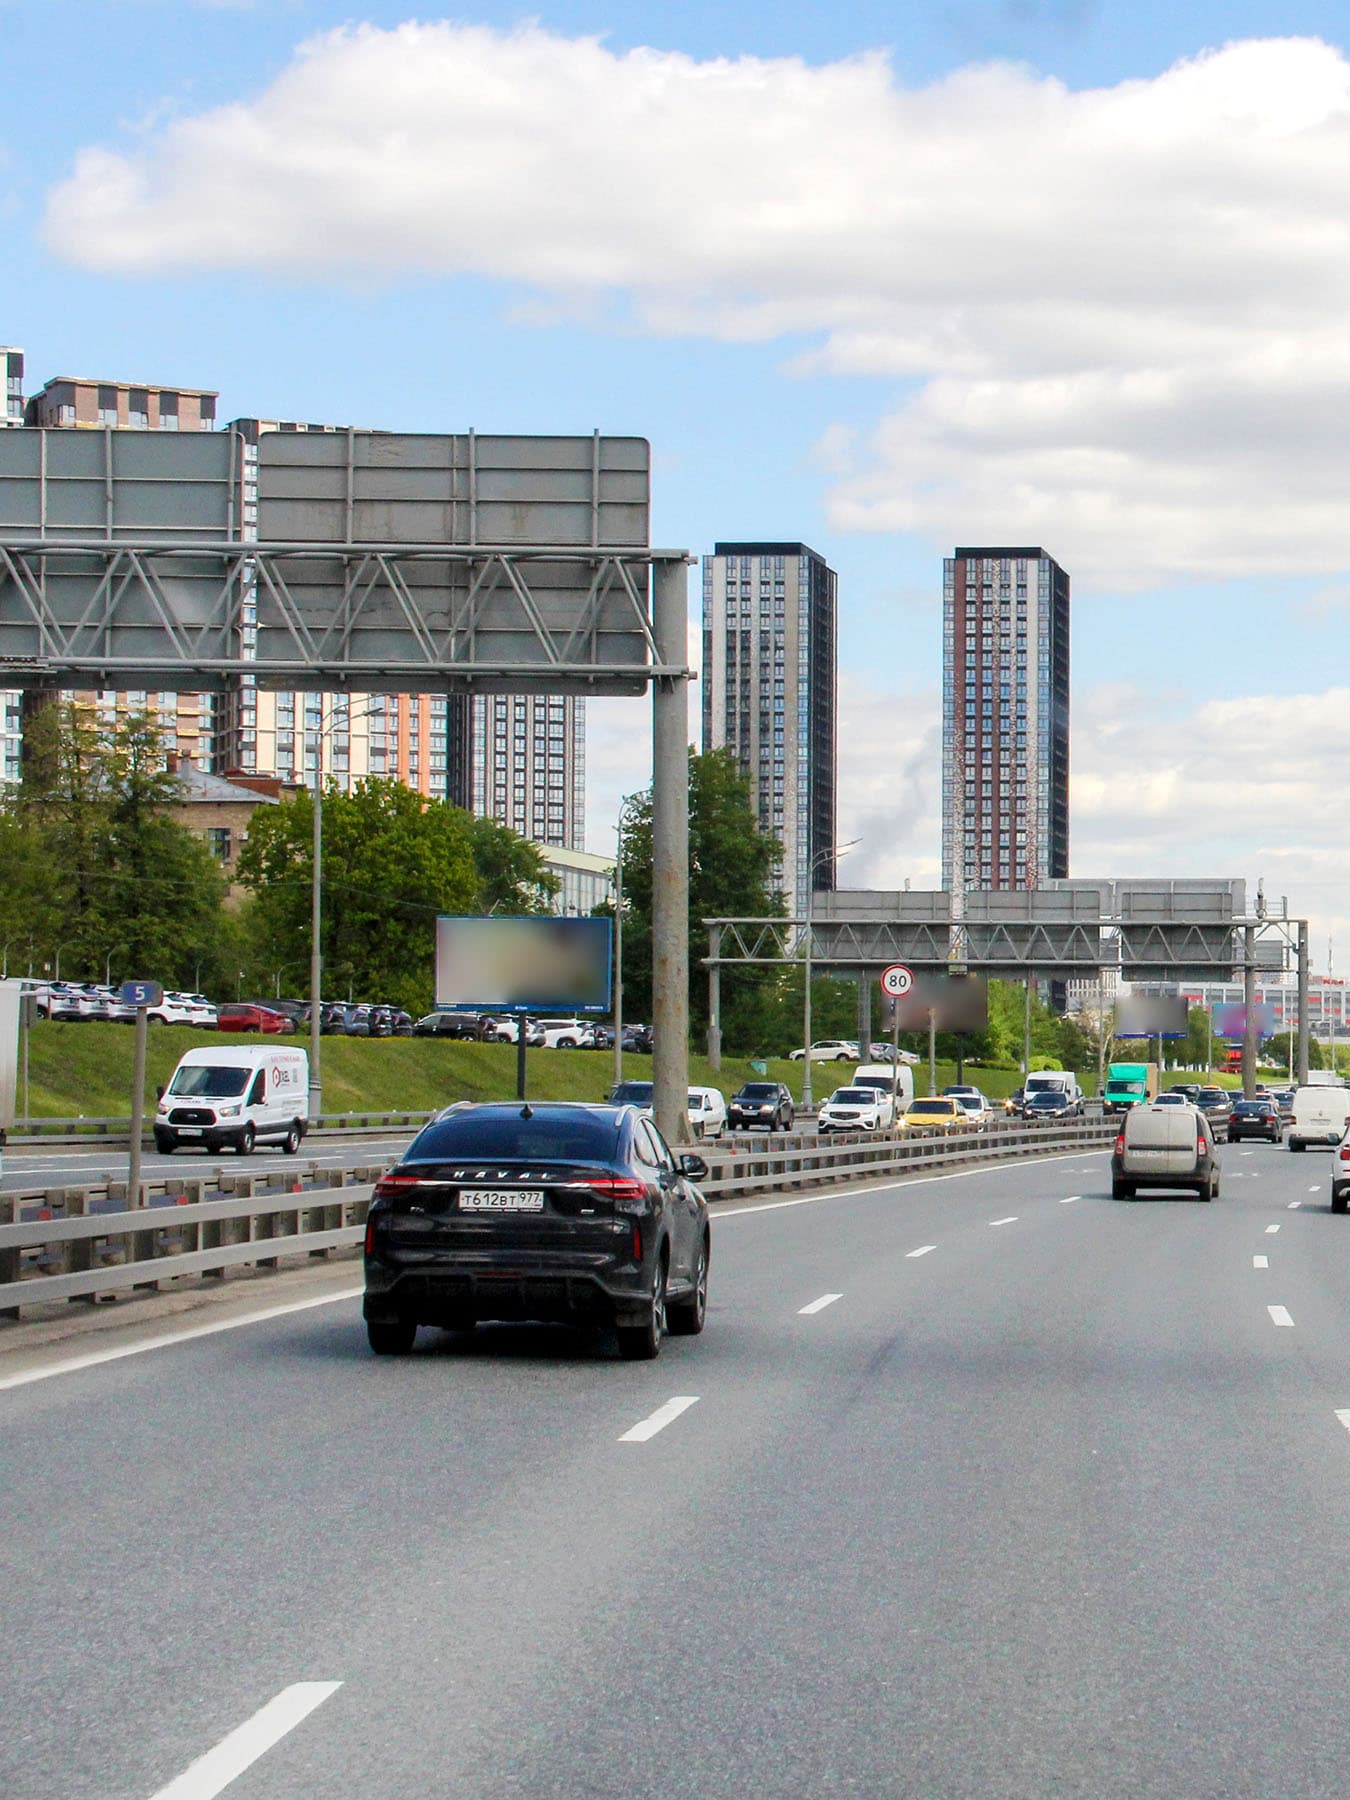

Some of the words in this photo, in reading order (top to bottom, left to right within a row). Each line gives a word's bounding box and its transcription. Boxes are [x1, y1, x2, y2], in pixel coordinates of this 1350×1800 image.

[889, 975, 907, 987] 80
[135, 985, 145, 1001] 5
[453, 1171, 551, 1179] HAVAL
[519, 1192, 540, 1203] 977
